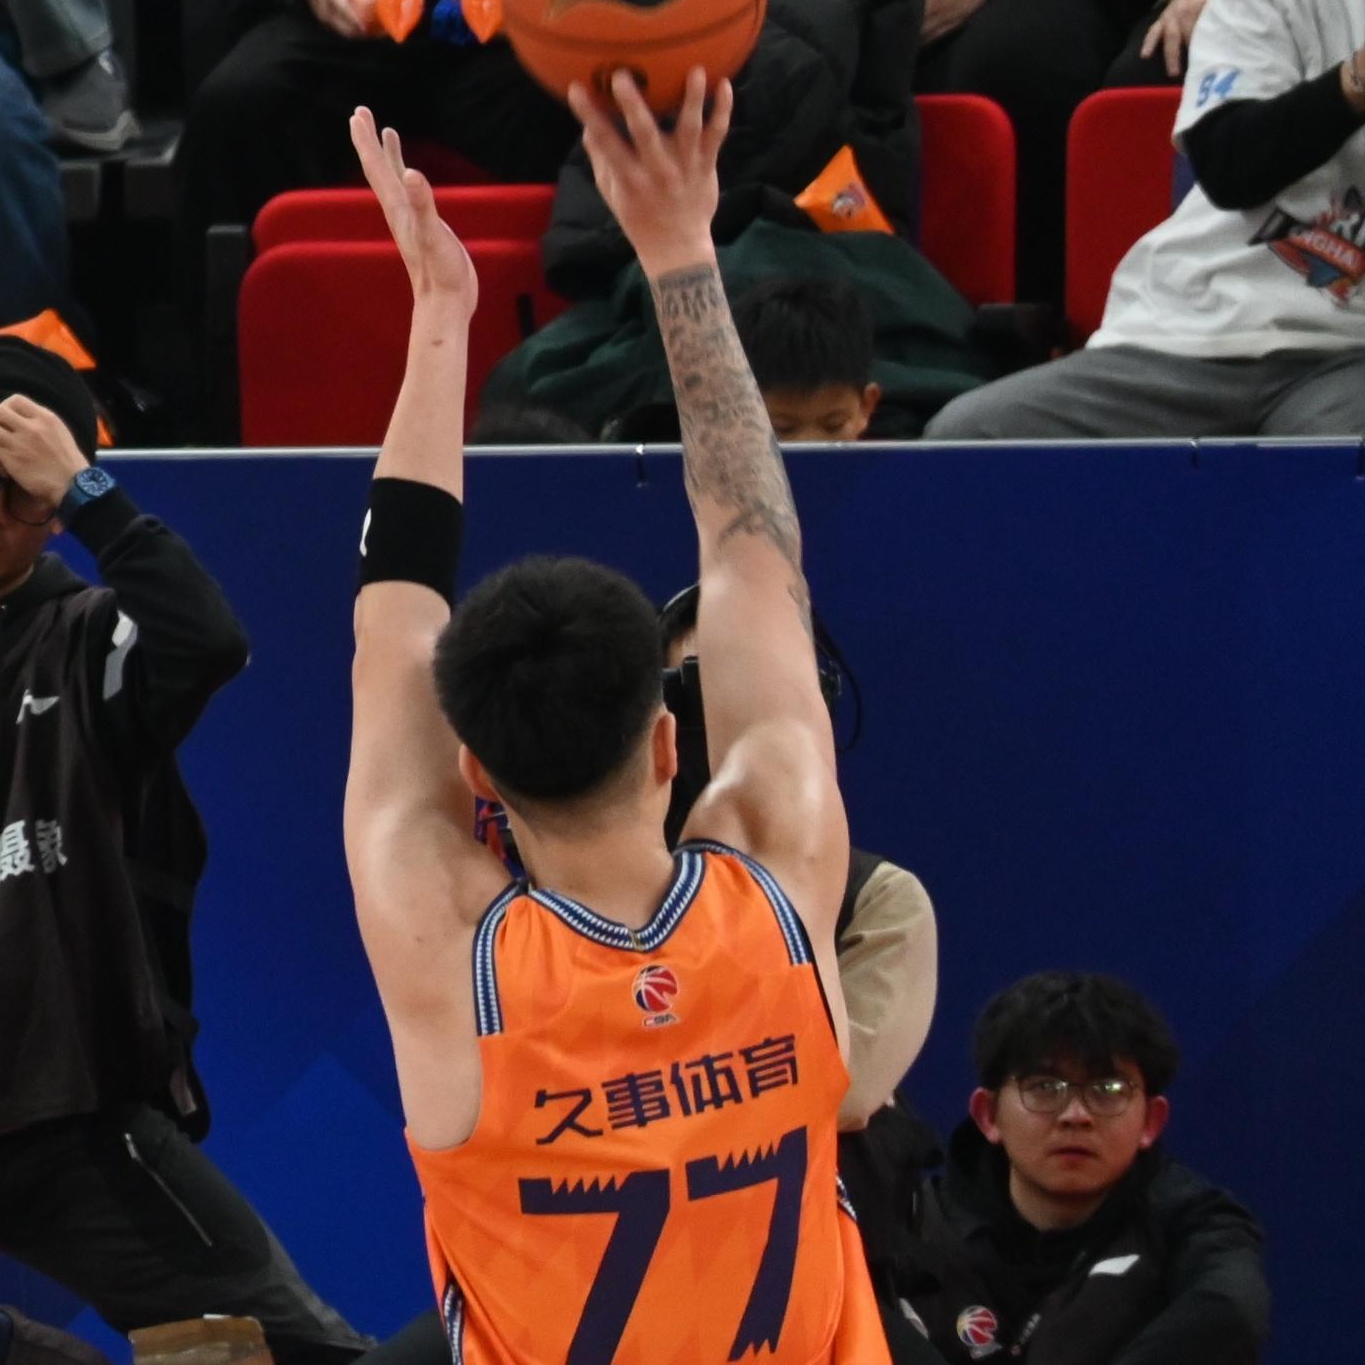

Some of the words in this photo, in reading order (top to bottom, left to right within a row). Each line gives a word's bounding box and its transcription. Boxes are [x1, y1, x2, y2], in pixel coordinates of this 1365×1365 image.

[643, 1012, 680, 1028] CBA
[533, 1032, 800, 1146] 久事体育
[517, 1123, 809, 1365] 77
